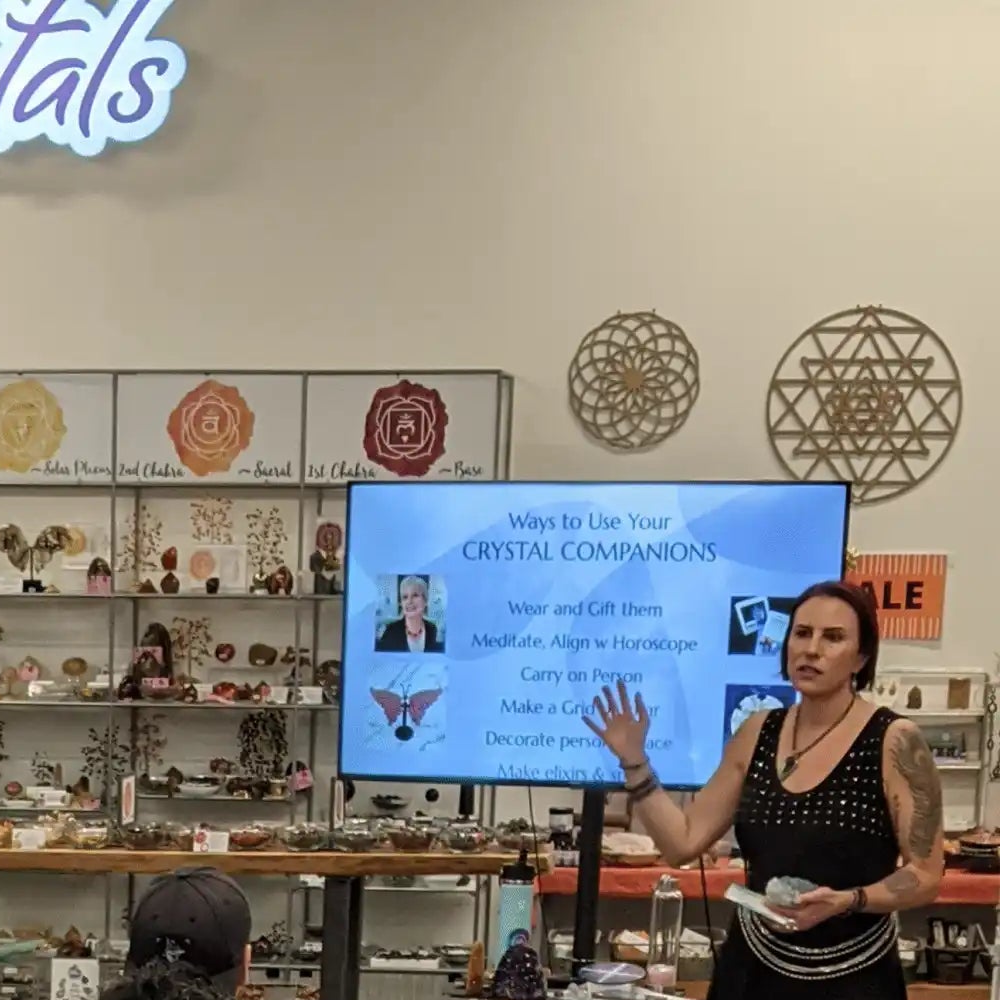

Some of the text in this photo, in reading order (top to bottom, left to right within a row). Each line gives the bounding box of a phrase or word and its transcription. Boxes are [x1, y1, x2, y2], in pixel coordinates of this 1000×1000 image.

[118, 461, 185, 478] 2nd Chakra
[253, 460, 292, 479] Sacral
[308, 461, 376, 480] 1st Chakra
[454, 461, 482, 479] Base
[508, 512, 672, 534] Ways to Use Your
[462, 541, 717, 563] CRYSTAL COMPANIONS
[859, 580, 924, 610] ALE
[508, 600, 662, 617] Wear and Gift them
[471, 633, 698, 655] Meditate, Align w Horoscope
[520, 666, 642, 686] Carry on Person
[500, 699, 595, 715] Make a Grid
[485, 731, 555, 747] Decorate
[560, 735, 606, 752] perso
[497, 763, 540, 780] Make
